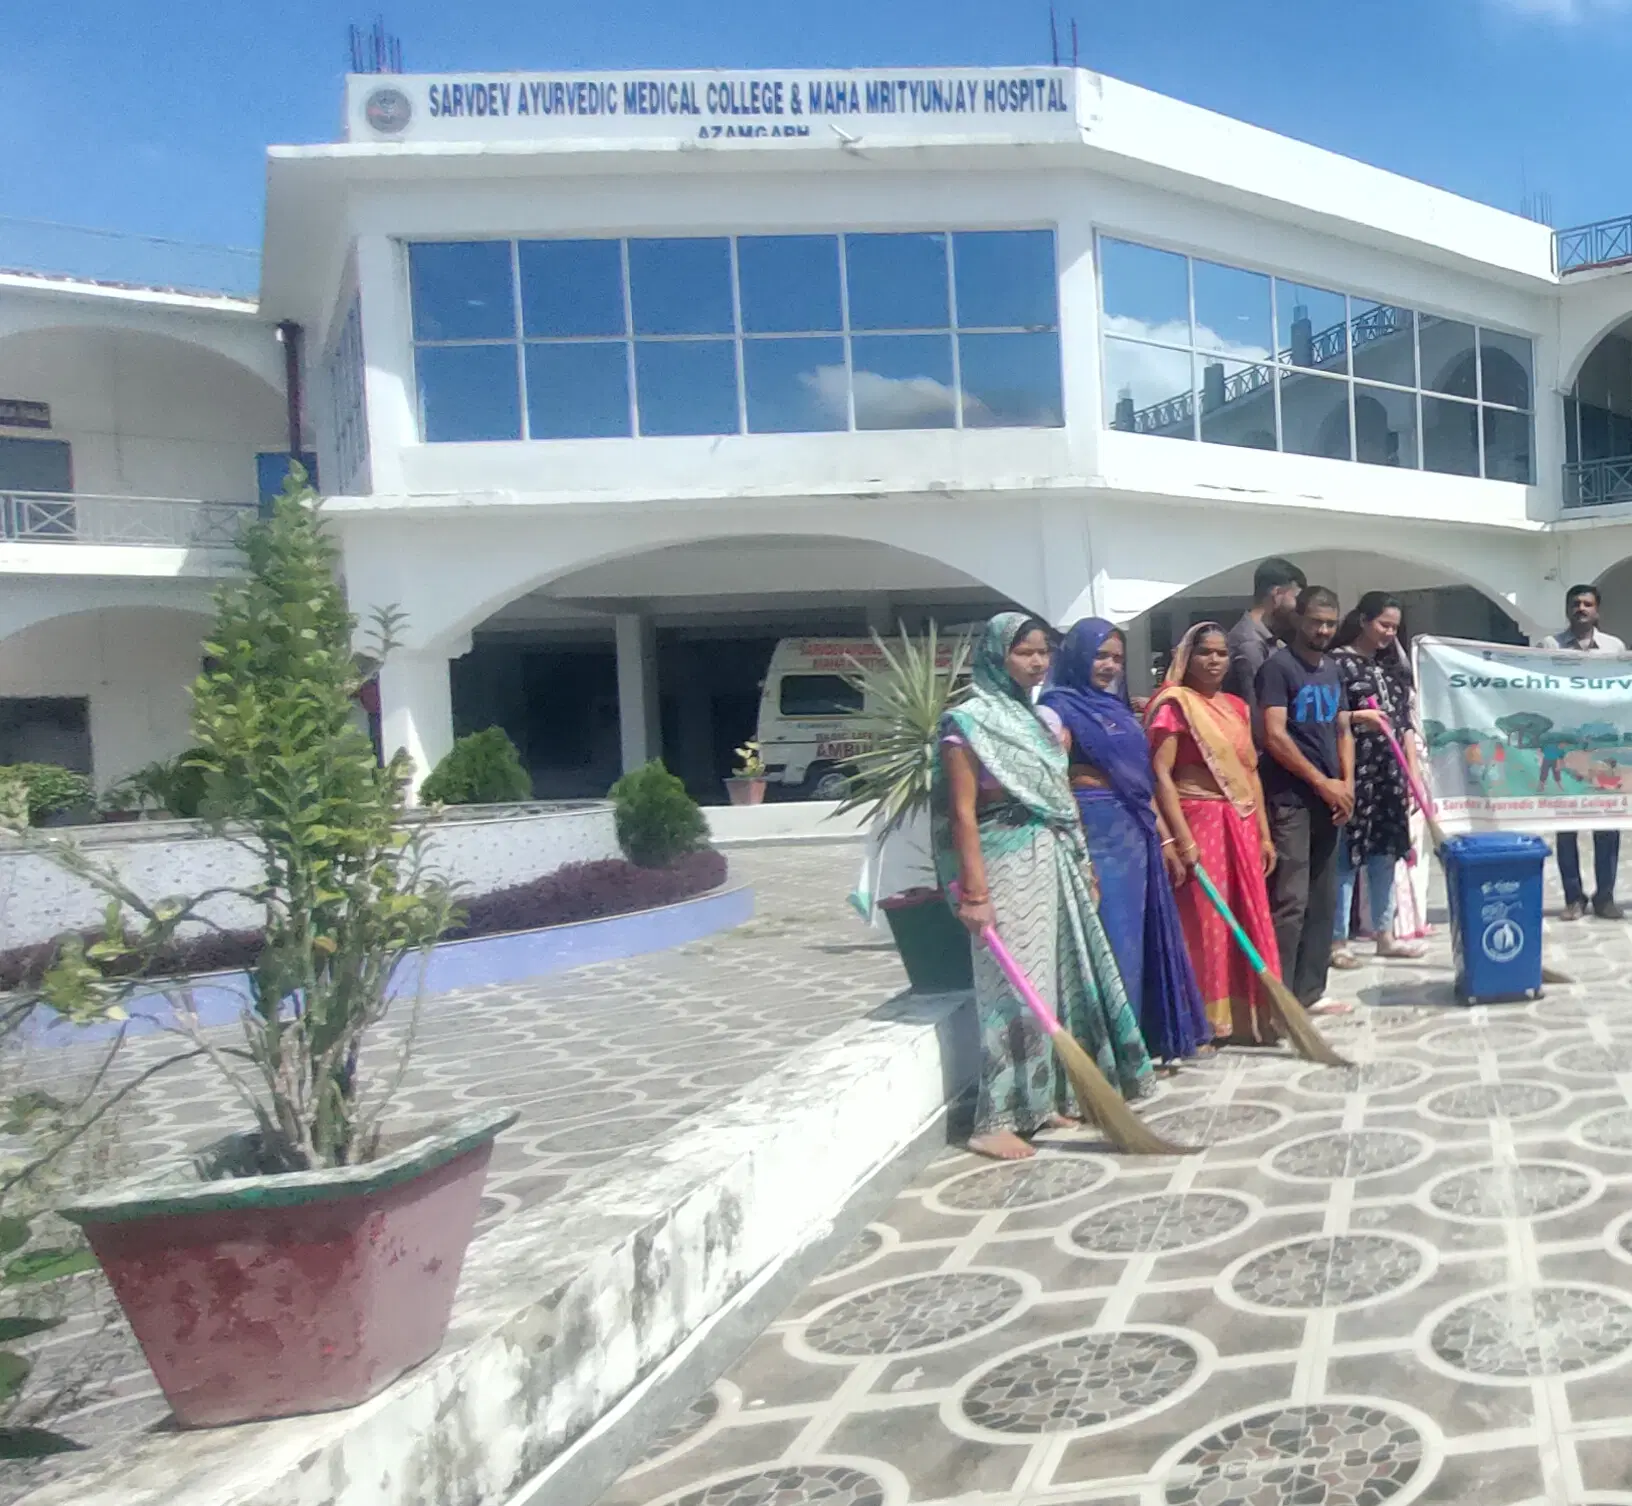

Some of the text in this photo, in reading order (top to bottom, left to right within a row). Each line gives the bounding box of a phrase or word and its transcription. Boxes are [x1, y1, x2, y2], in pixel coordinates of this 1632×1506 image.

[429, 78, 1069, 118] SARVDEV AYURVEDIC MEDICAL COLLEGE & MAHA MRITYUNJAY HOSPITAL
[1448, 673, 1560, 690] Swachh
